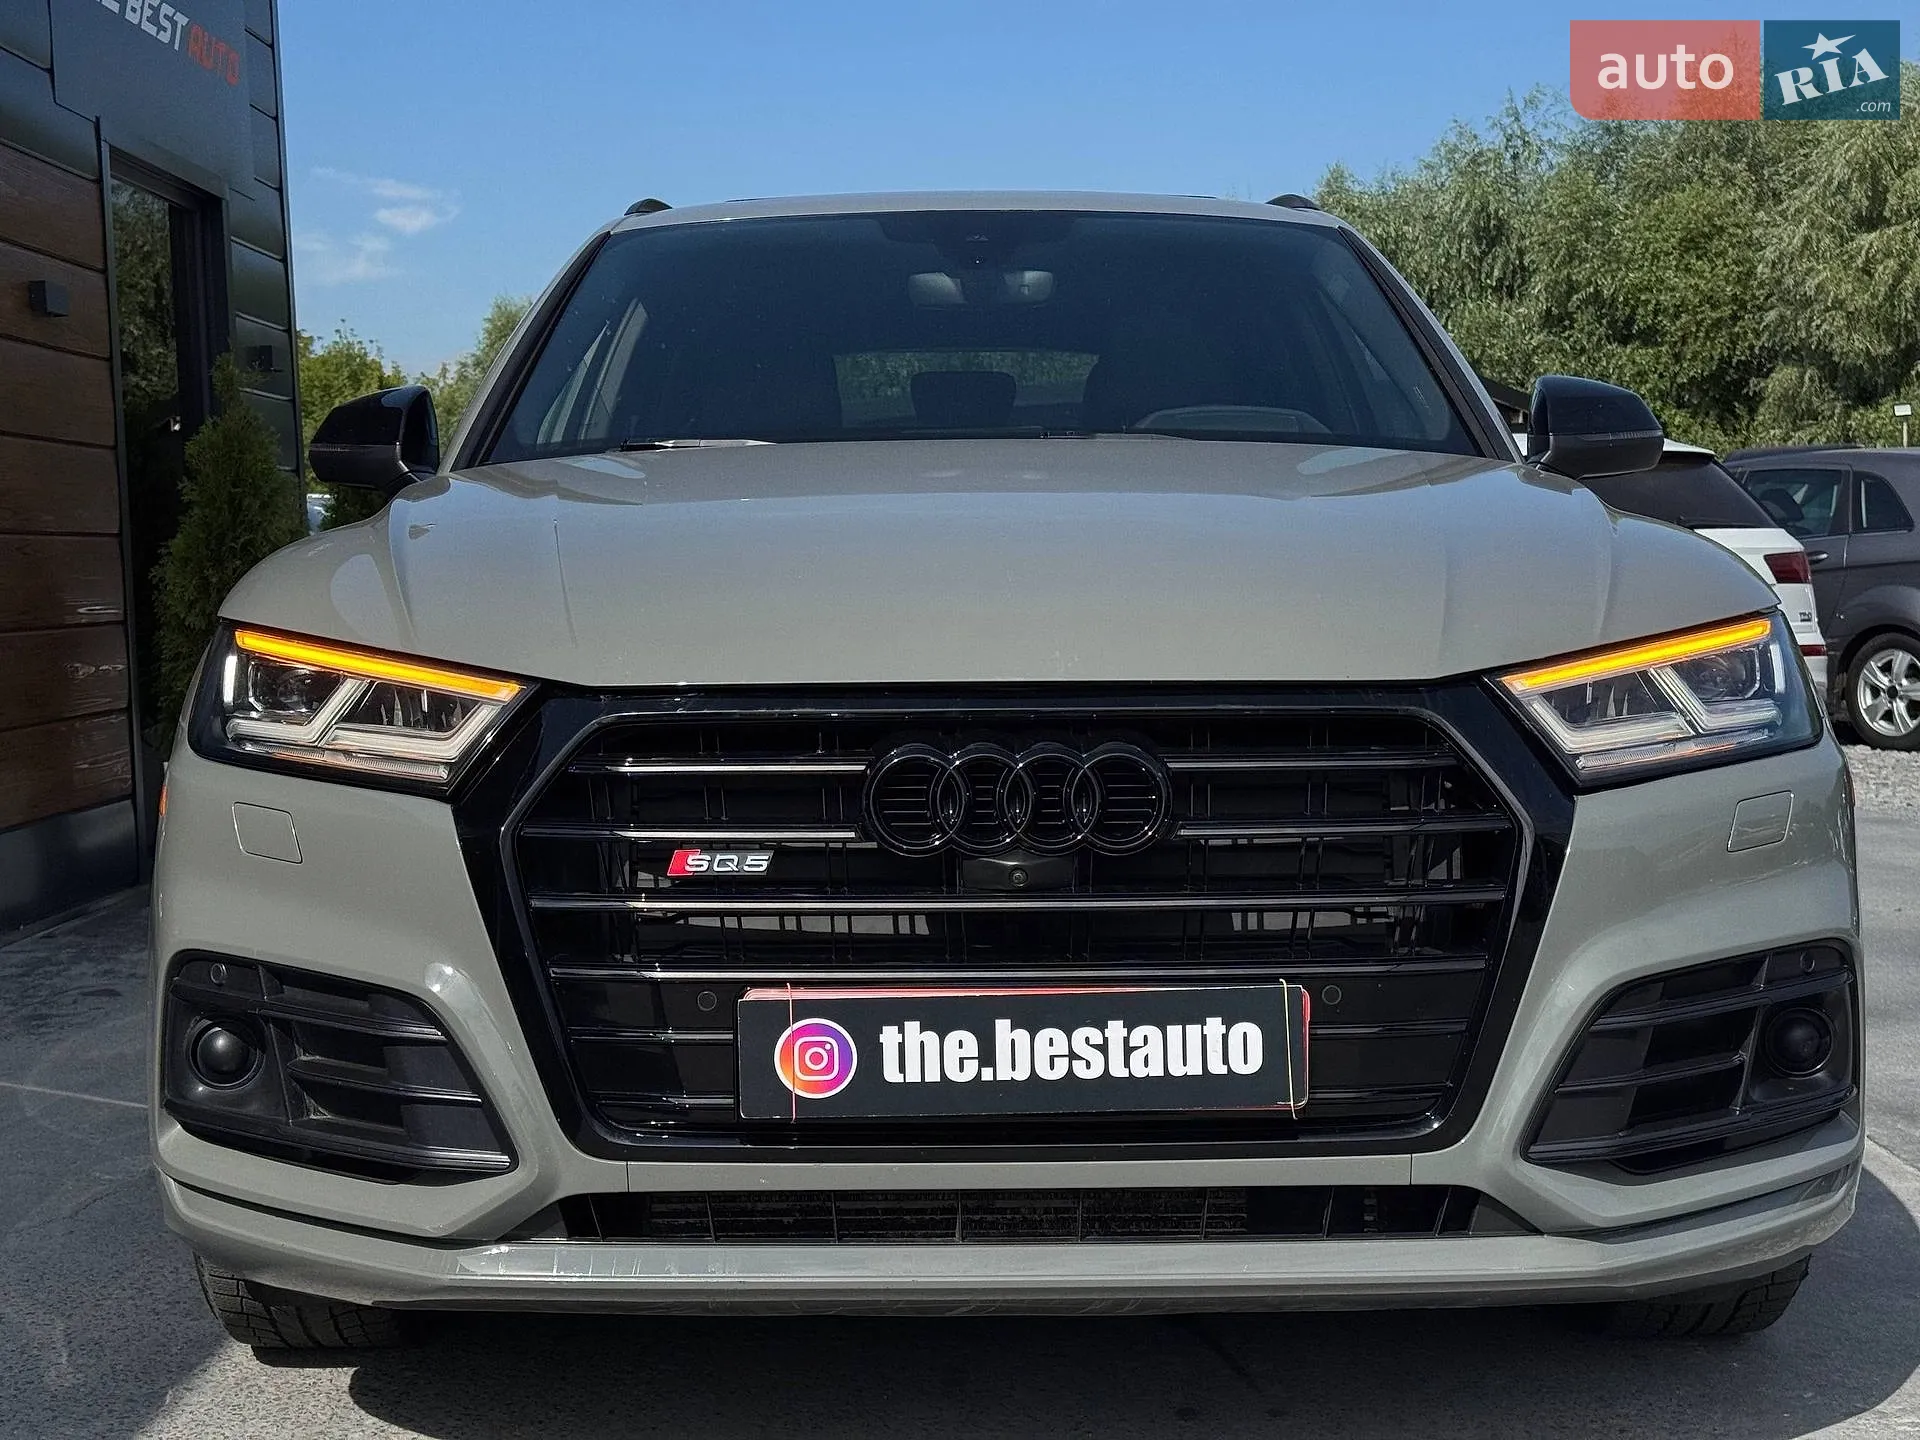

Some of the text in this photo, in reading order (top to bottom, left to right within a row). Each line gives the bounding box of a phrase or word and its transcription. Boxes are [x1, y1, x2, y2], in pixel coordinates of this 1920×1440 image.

[125, 0, 240, 85] BEST AUTO
[684, 853, 770, 873] SQ5
[879, 1016, 1264, 1084] the.bestauto
